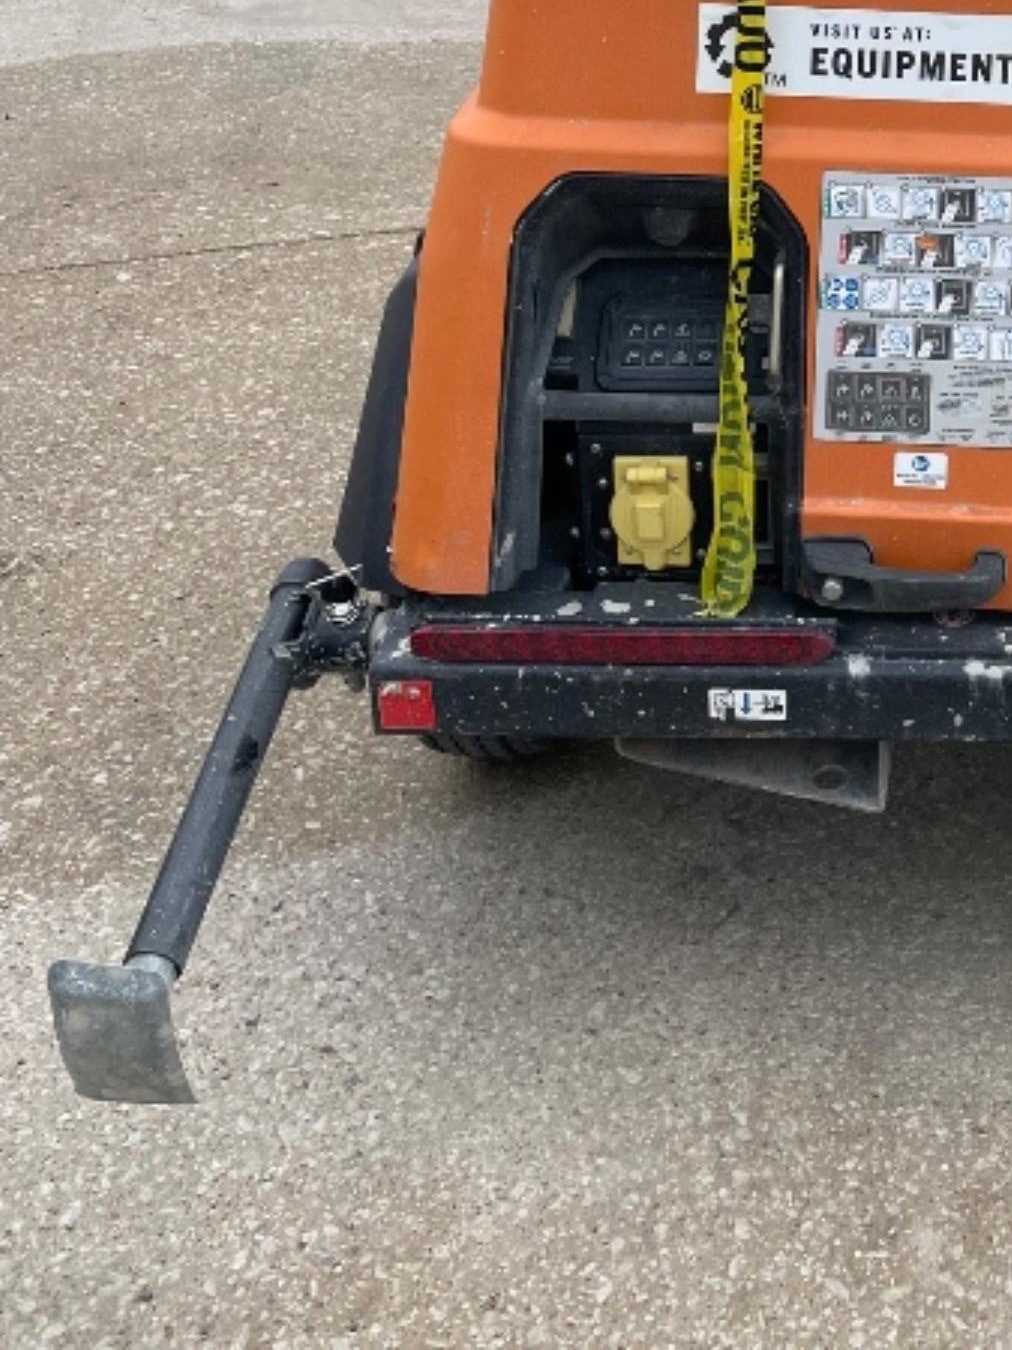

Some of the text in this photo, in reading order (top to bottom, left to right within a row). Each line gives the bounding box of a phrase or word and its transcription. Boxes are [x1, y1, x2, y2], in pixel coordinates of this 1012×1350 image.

[810, 23, 932, 42] VISIT US AT:
